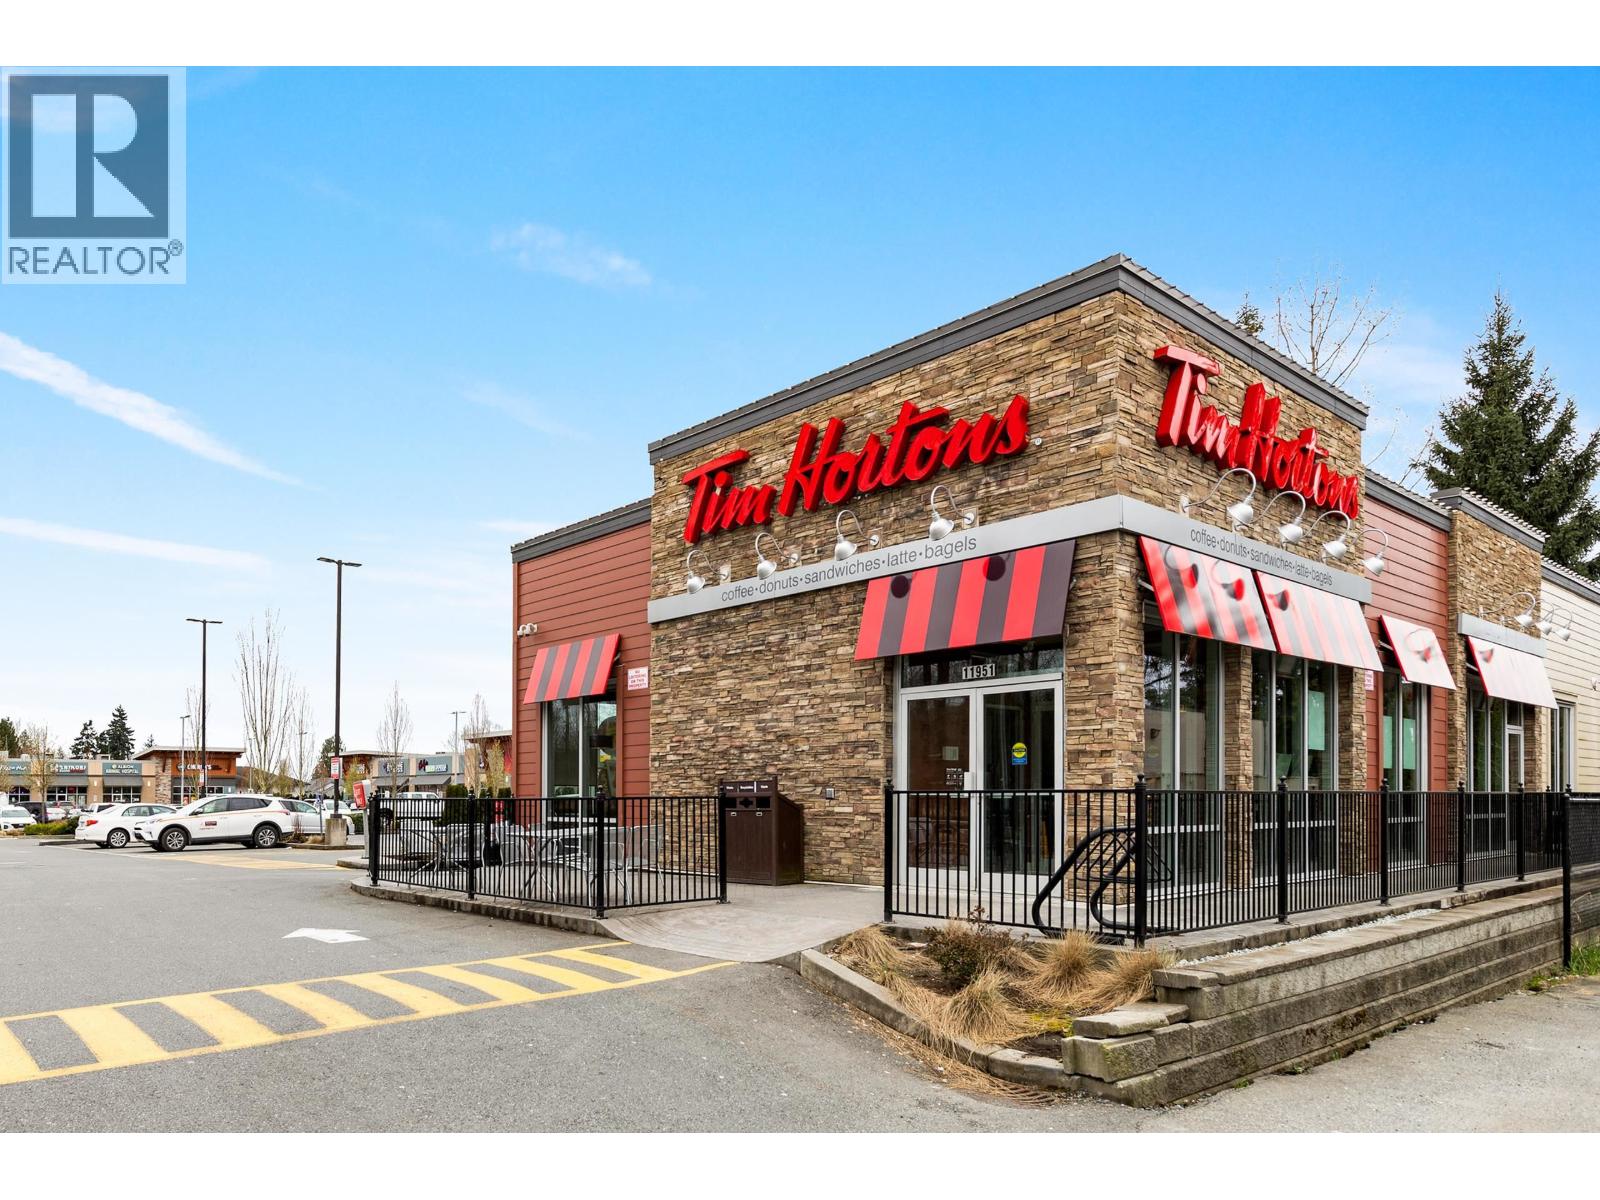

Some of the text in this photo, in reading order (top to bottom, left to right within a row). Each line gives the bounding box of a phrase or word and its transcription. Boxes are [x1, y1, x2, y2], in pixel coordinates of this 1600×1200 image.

[1154, 345, 1240, 472] Tim
[681, 393, 1030, 544] Tim Hortons
[721, 536, 977, 602] coffee donuts sandwiches latte bagels
[963, 664, 995, 679] 11951
